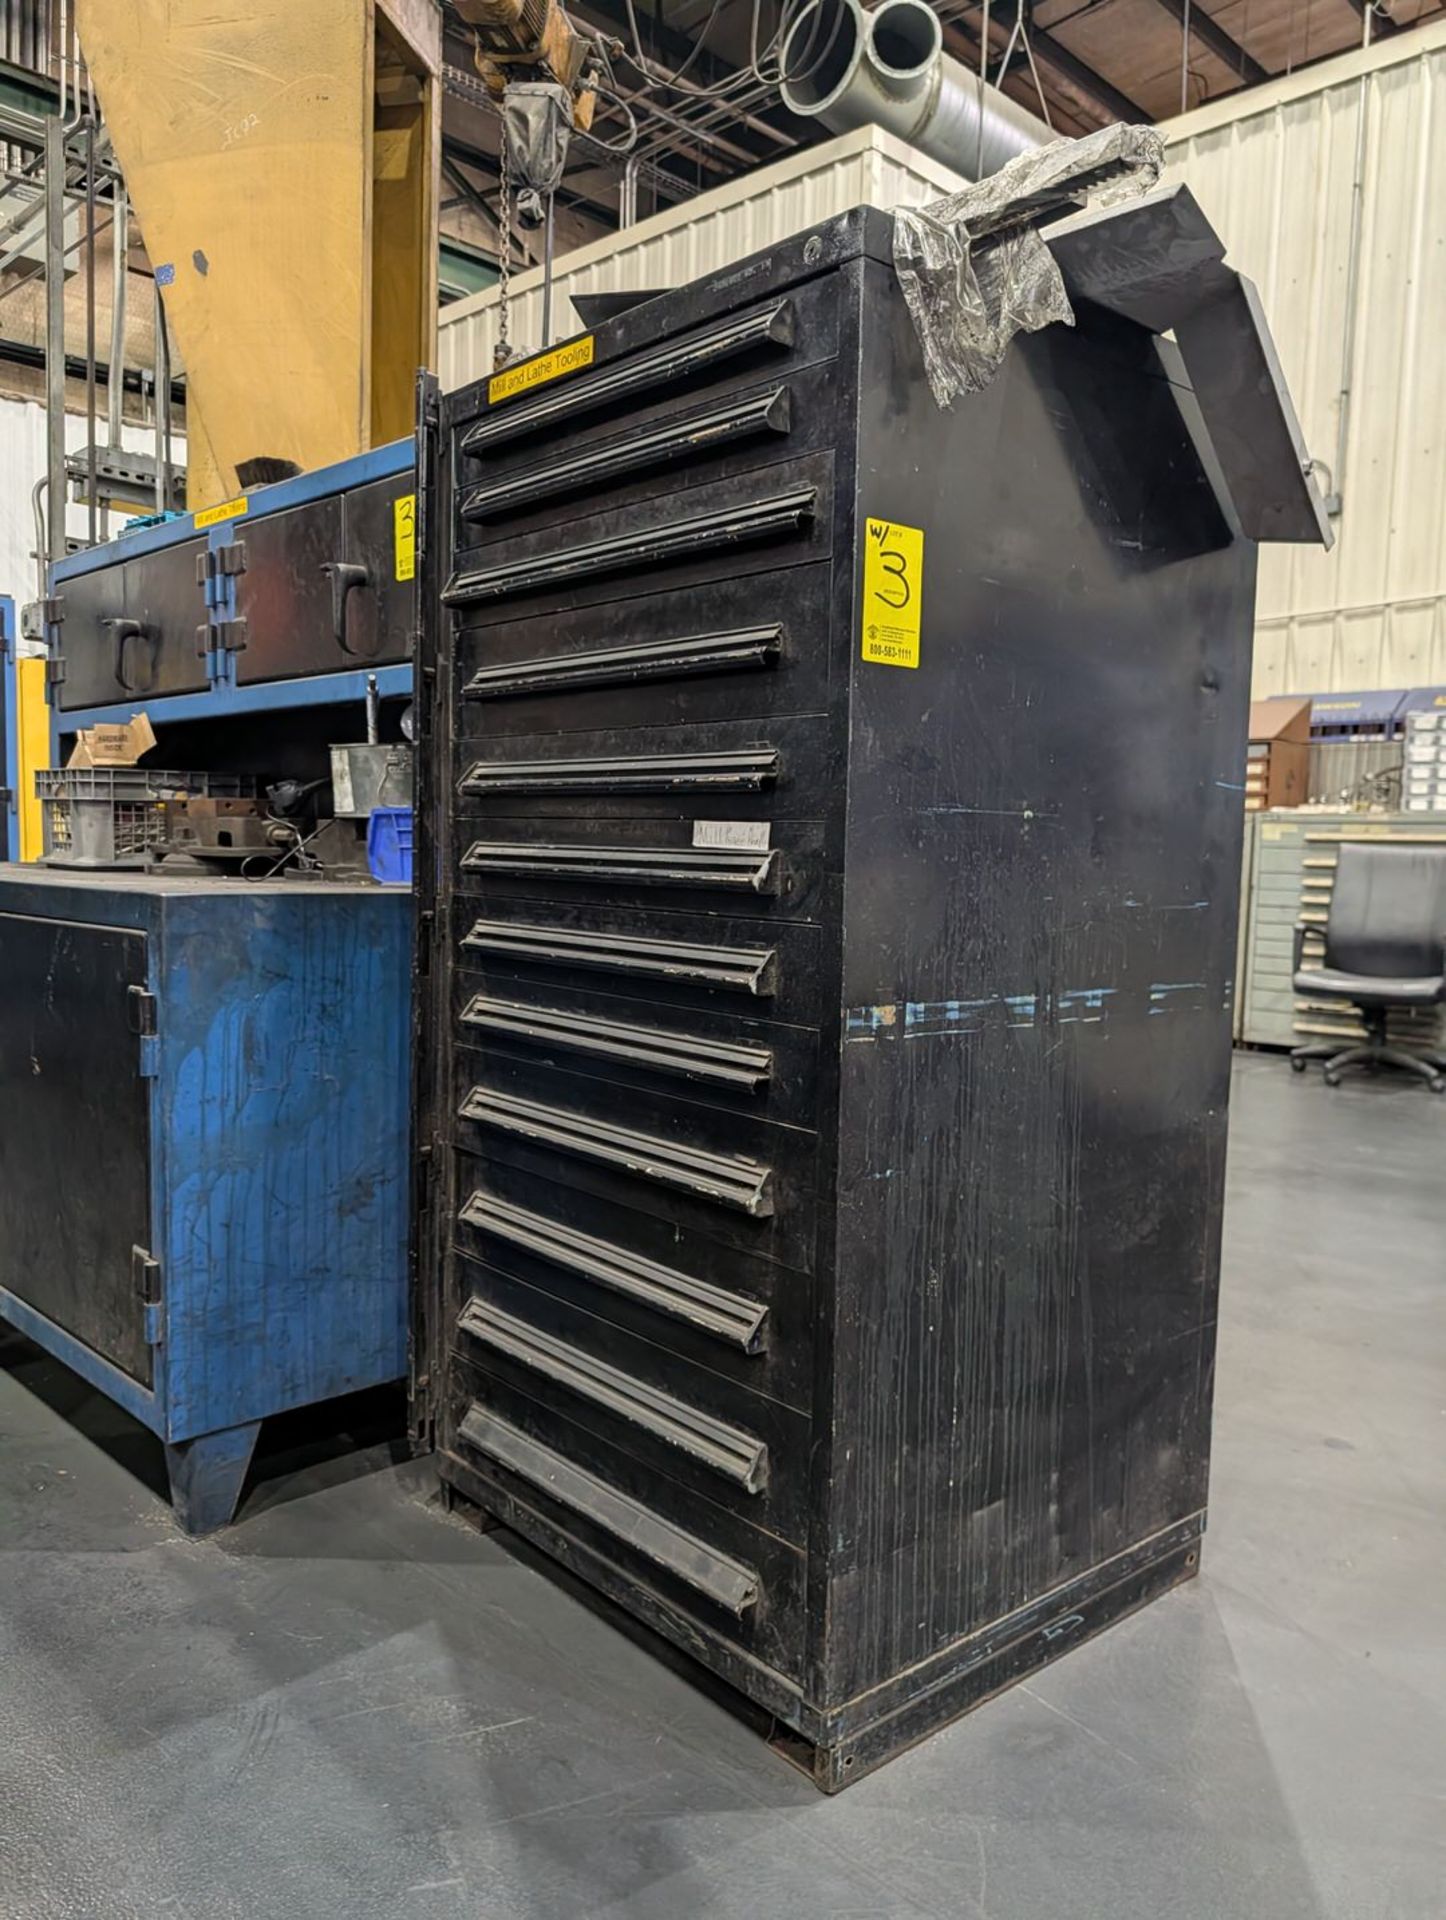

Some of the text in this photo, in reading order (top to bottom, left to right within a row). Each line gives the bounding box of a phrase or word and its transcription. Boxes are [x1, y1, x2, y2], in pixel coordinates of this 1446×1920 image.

[492, 346, 590, 394] Mill and Lathe Tooling
[399, 500, 413, 540] 3
[875, 551, 910, 609] 3
